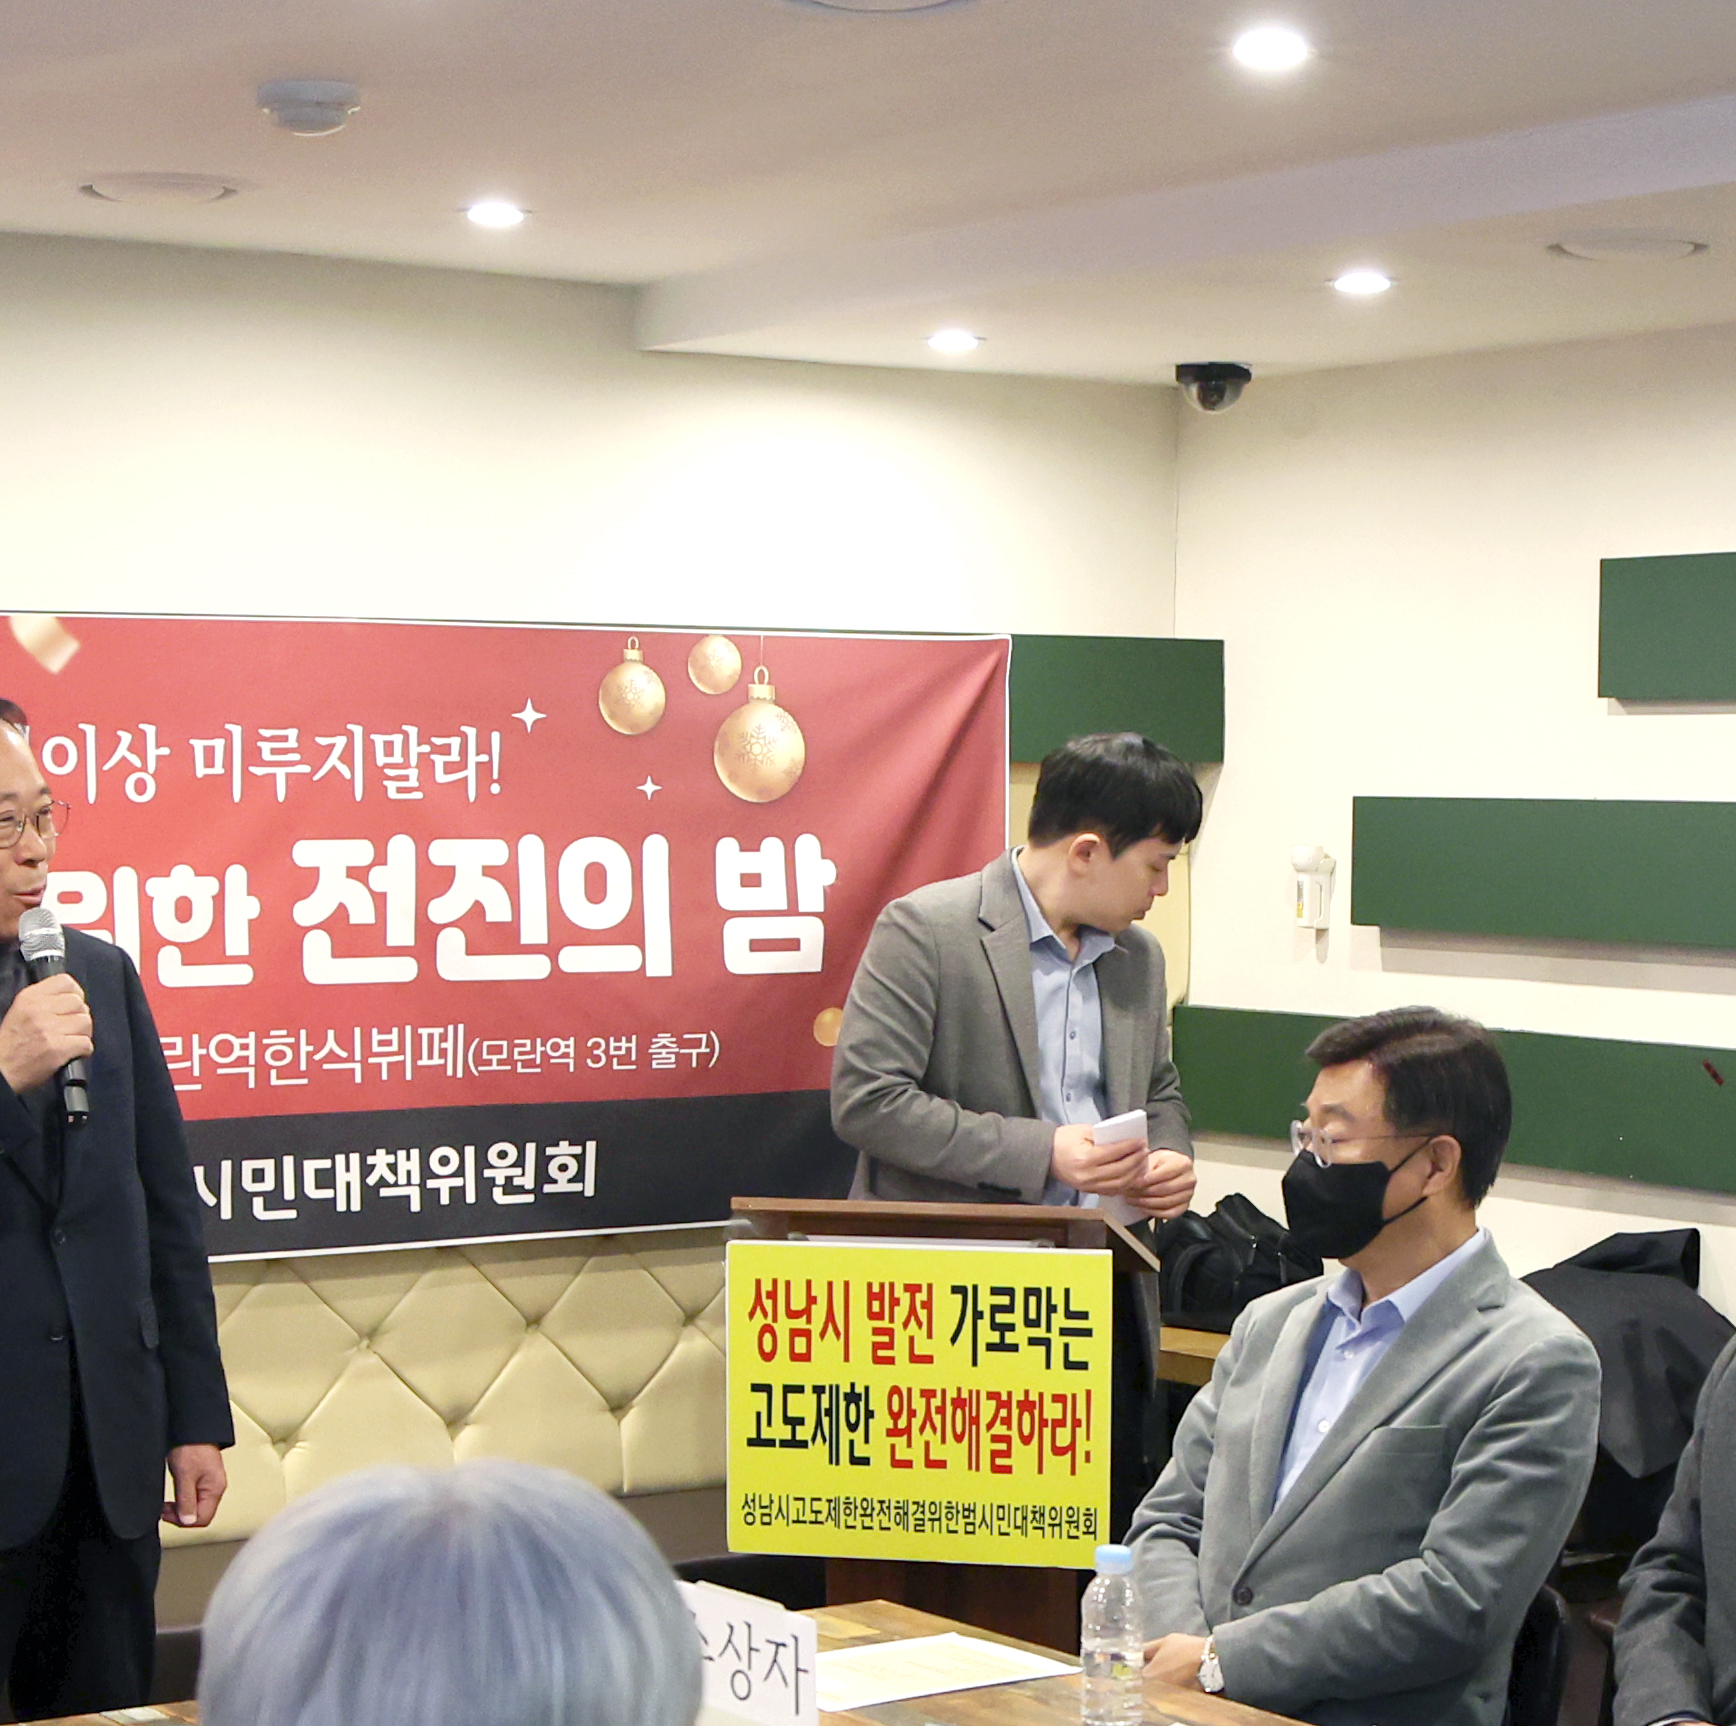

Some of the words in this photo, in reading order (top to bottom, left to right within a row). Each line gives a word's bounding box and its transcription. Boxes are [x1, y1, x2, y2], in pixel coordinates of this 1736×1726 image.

[19, 722, 170, 804] 이상
[191, 723, 502, 803] 미루지말라!
[291, 833, 672, 986] 전진의
[713, 834, 836, 975] 밤
[586, 1034, 637, 1071] 3번
[648, 1030, 721, 1069] 출구)
[748, 1278, 851, 1363] 성남시
[866, 1281, 934, 1366] 발전
[950, 1284, 1094, 1371] 가로막는
[746, 1382, 874, 1466] 고도제한
[885, 1385, 1093, 1476] 완전해결하라!
[740, 1492, 1099, 1541] 성남시고도제한완전해결위한범시민대책위원회
